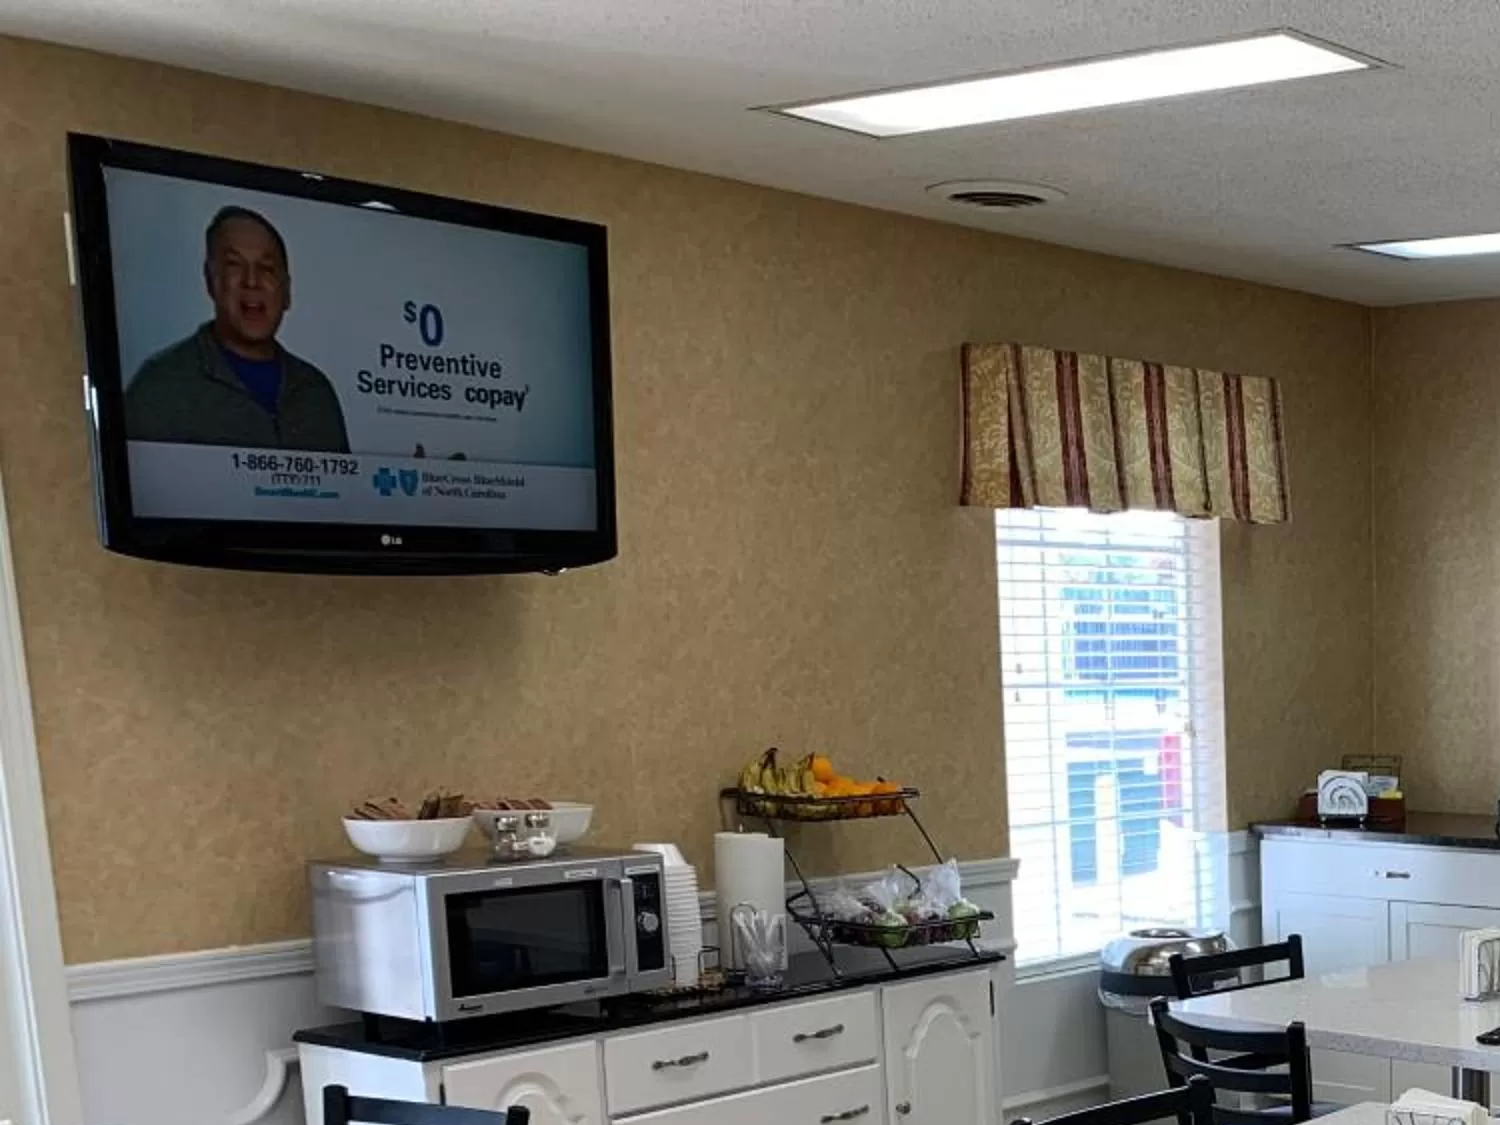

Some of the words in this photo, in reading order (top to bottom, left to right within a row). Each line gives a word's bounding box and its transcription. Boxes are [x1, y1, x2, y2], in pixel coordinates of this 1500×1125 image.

[403, 300, 444, 347] $0
[379, 343, 502, 379] Preventive
[357, 370, 452, 401] Services
[232, 453, 361, 475] 1-866-760-1792
